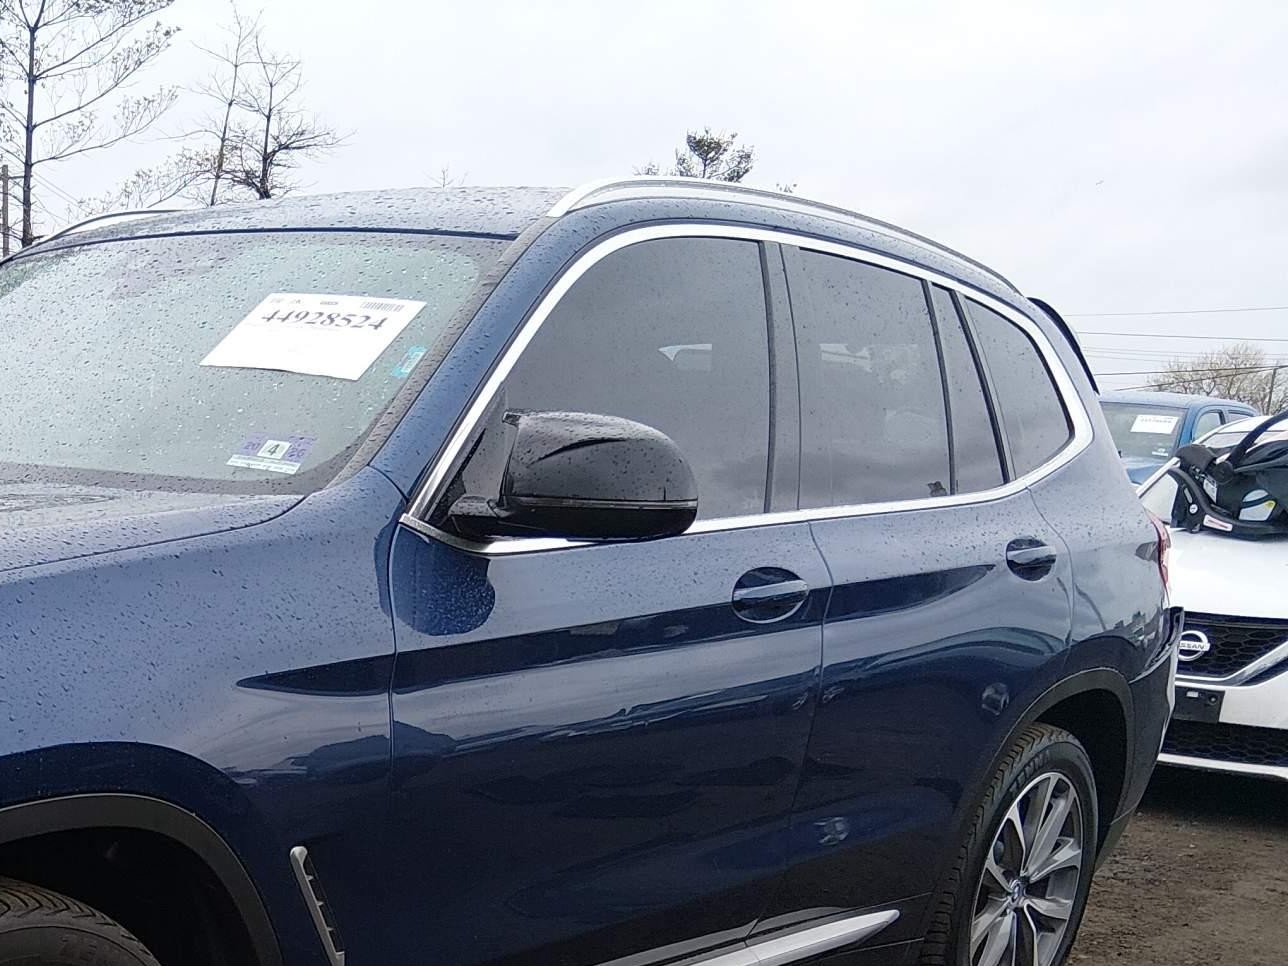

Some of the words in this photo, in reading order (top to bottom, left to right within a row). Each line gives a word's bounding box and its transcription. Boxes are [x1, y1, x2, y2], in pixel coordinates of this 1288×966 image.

[261, 309, 388, 330] 44928524
[268, 443, 280, 456] 4
[1179, 642, 1205, 650] SSAN
